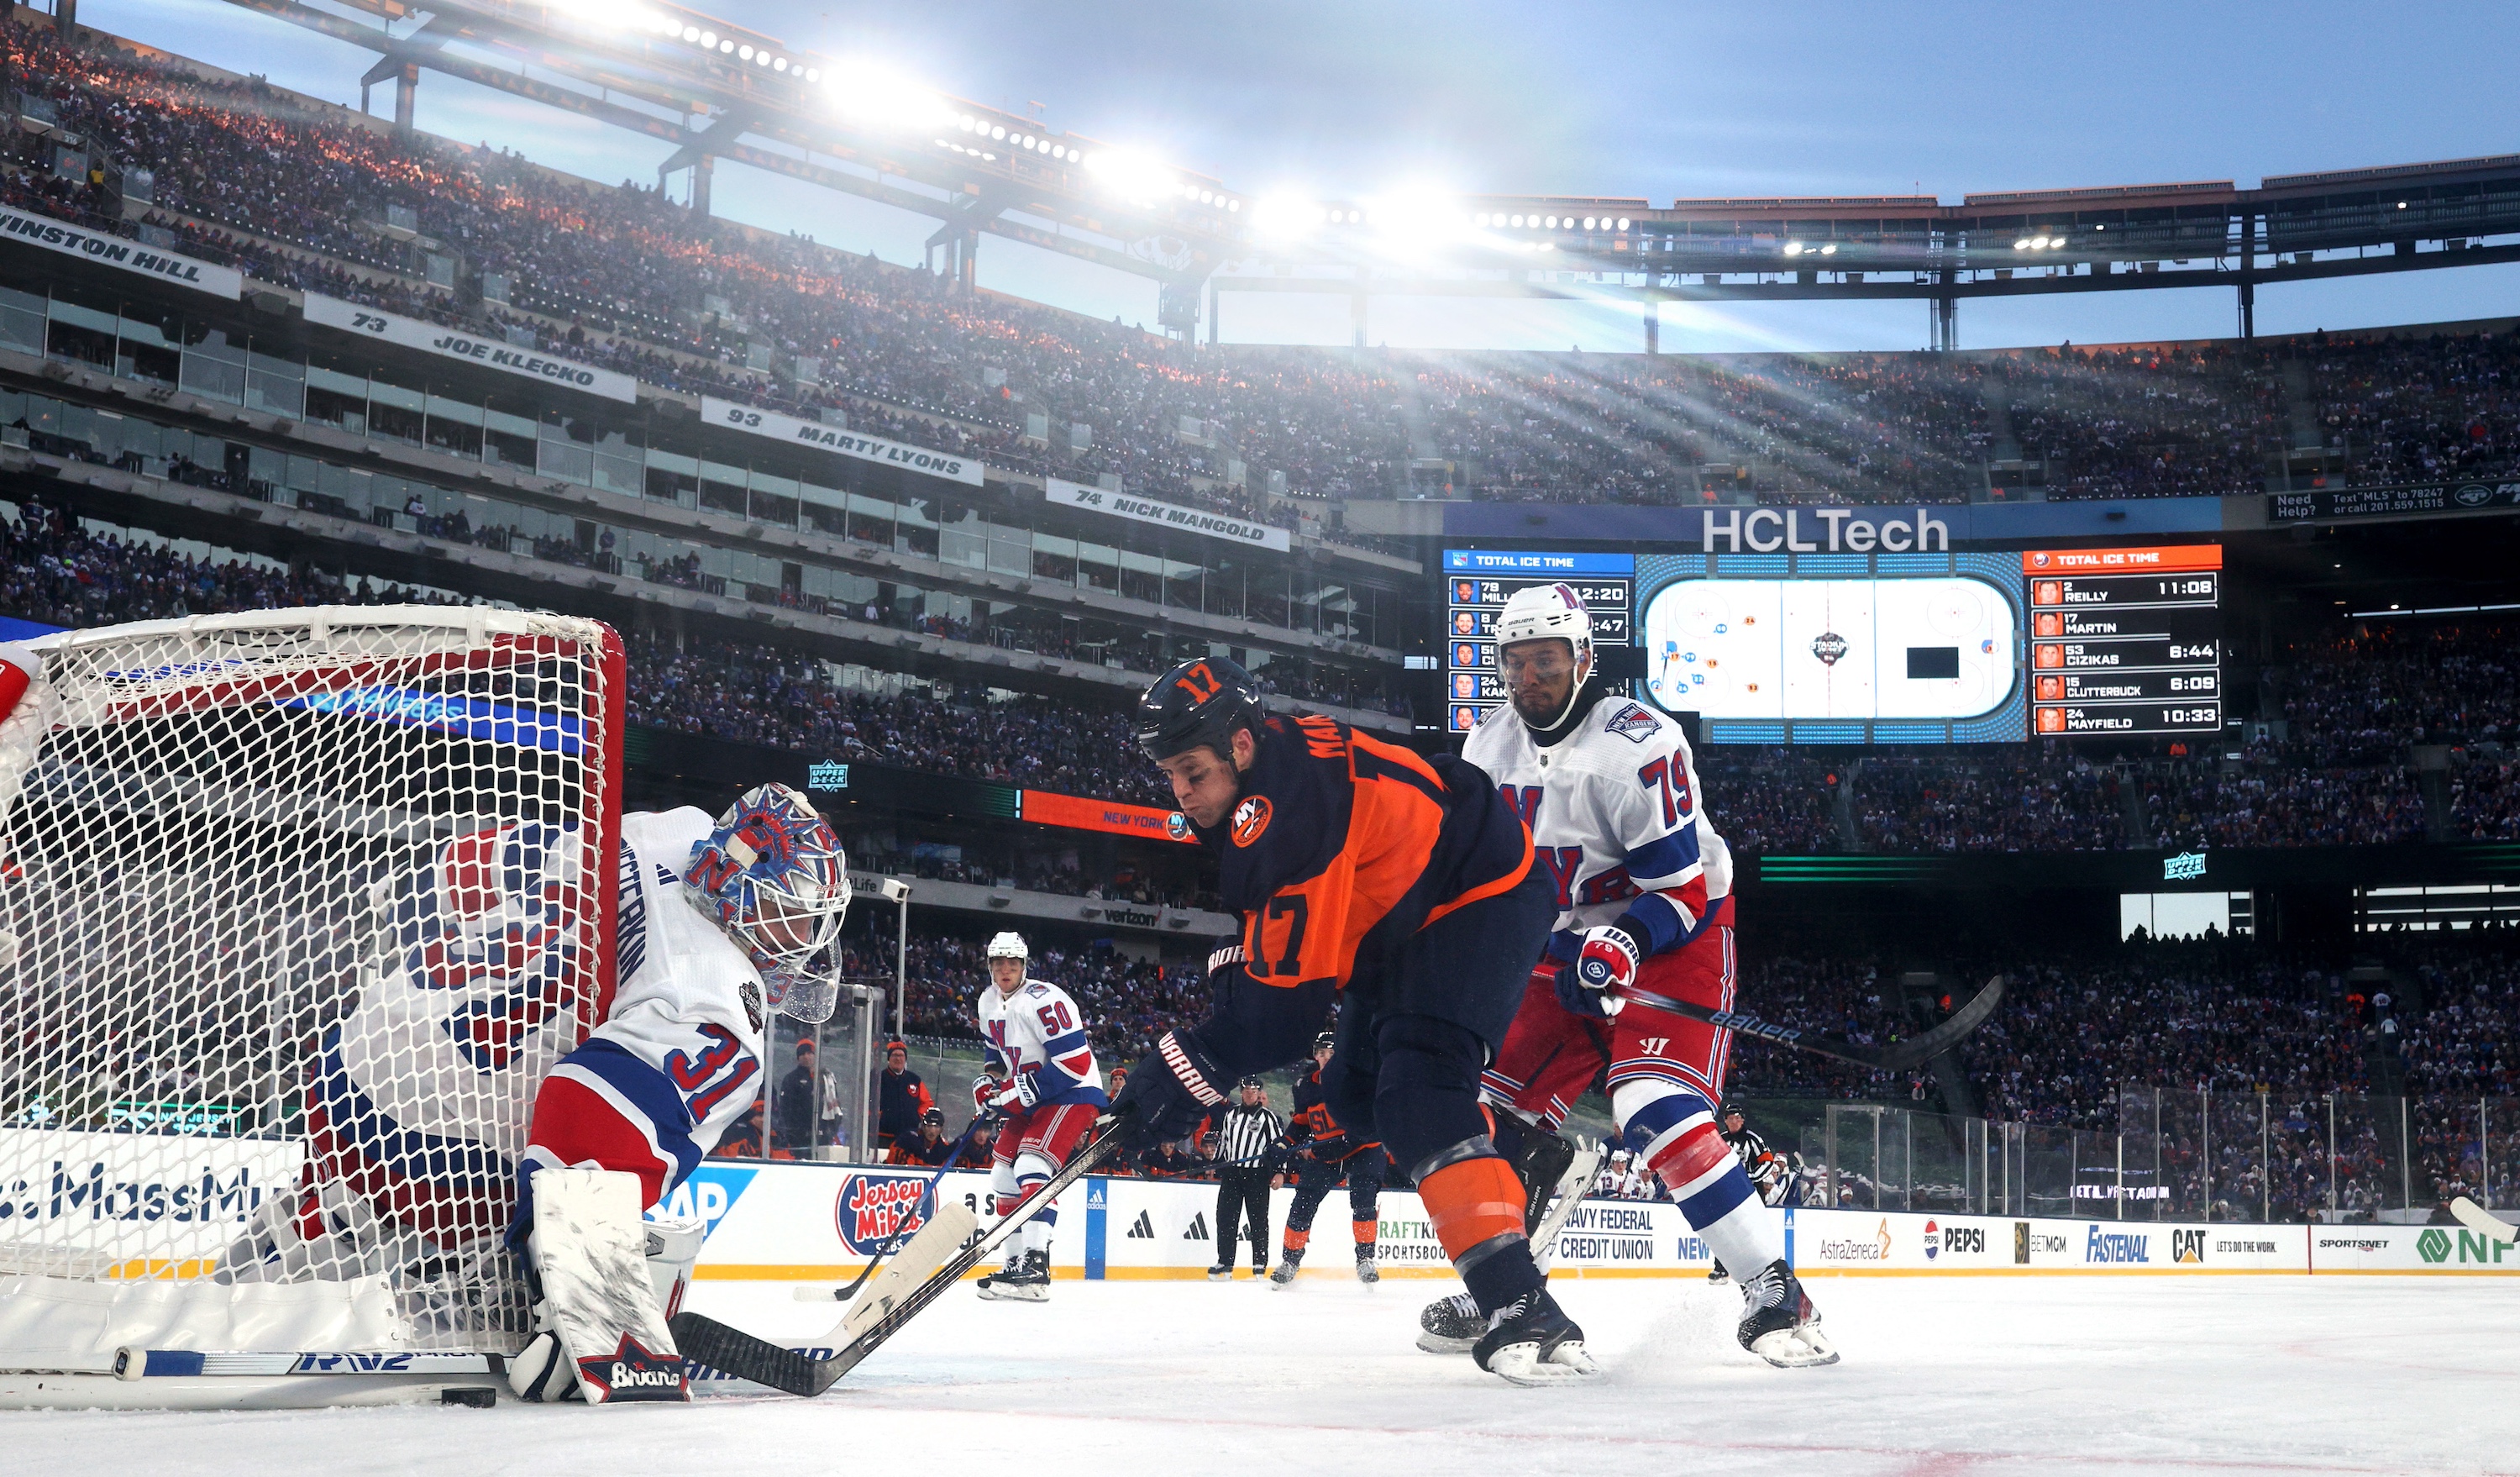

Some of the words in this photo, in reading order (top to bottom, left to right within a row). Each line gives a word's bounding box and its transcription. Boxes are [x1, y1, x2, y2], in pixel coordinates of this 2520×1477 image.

[131, 251, 200, 283] HILL
[350, 313, 388, 333] 73
[433, 336, 490, 359] JOE
[491, 350, 595, 386] KLECKO
[727, 408, 762, 427] 93
[798, 426, 885, 455] MARTY
[887, 447, 962, 475] LYONS
[2277, 494, 2312, 505] Need
[2333, 494, 2357, 503] Text
[2411, 488, 2444, 498] 78247
[2348, 503, 2367, 512] call
[2370, 498, 2444, 512] 201.559.1515
[1074, 490, 1102, 506] 74
[1113, 498, 1165, 519] NICK
[1166, 509, 1265, 541] MANGOLD
[2278, 505, 2316, 518] Help?
[1703, 508, 1949, 552] HCLTech
[1476, 555, 1517, 567] TOTAL
[1520, 557, 1541, 567] ICE
[1543, 558, 1574, 568] TIME
[2058, 555, 2100, 565] TOTAL
[2103, 554, 2124, 564] ICE
[2128, 553, 2159, 562] TIME
[1481, 582, 1499, 592] 79
[2063, 581, 2072, 591] 2
[2065, 591, 2108, 602] REILLY
[2160, 581, 2212, 594] 11:08
[1481, 613, 1490, 623] 8
[2064, 613, 2077, 623] 17
[2066, 623, 2117, 633] MARTIN
[2066, 645, 2084, 654] 53
[2066, 654, 2119, 665] CIZIKAS
[2169, 645, 2214, 659] 6:44
[1176, 663, 1221, 704] 17
[1481, 676, 1498, 686] 24
[2066, 677, 2080, 686] 15
[2067, 686, 2141, 698] CLUTTERBUCK
[2170, 677, 2215, 691] 6:09
[2066, 709, 2084, 718] 24
[2067, 719, 2133, 729] MAYFIELD
[2163, 709, 2216, 723] 10:33
[1625, 720, 1656, 728] RANGERS
[1638, 749, 1693, 830] 79
[1104, 811, 1131, 825] NEW
[1134, 816, 1165, 829] YORK
[2168, 858, 2202, 869] UPPER
[1105, 908, 1157, 928] verizon
[1247, 894, 1308, 978] 17
[1595, 942, 1614, 954] 79
[1037, 1001, 1074, 1037] 50
[1709, 1010, 1802, 1047] BAUER
[664, 1022, 761, 1125] 31
[1158, 1030, 1224, 1107] WARRIOR
[850, 1177, 924, 1210] Jersey
[1529, 1185, 1541, 1217] BAUER
[1088, 1201, 1106, 1210] adidas
[1600, 1209, 1653, 1230] FEDERAL
[1561, 1238, 1609, 1259] CREDIT
[1612, 1238, 1653, 1260] UNION
[1924, 1235, 1939, 1243] PEPSI
[1945, 1227, 1985, 1253] PEPSI
[2030, 1235, 2066, 1253] BETMGM
[2086, 1225, 2150, 1263] FASTENAL
[2173, 1229, 2206, 1263] CAT
[2217, 1241, 2232, 1252] LET'S
[2233, 1242, 2242, 1253] DO
[2243, 1242, 2255, 1253] THE
[2256, 1241, 2277, 1253] WORK.
[2319, 1239, 2389, 1248] SPORTSNET
[1820, 1239, 1879, 1260] AstraZeneca
